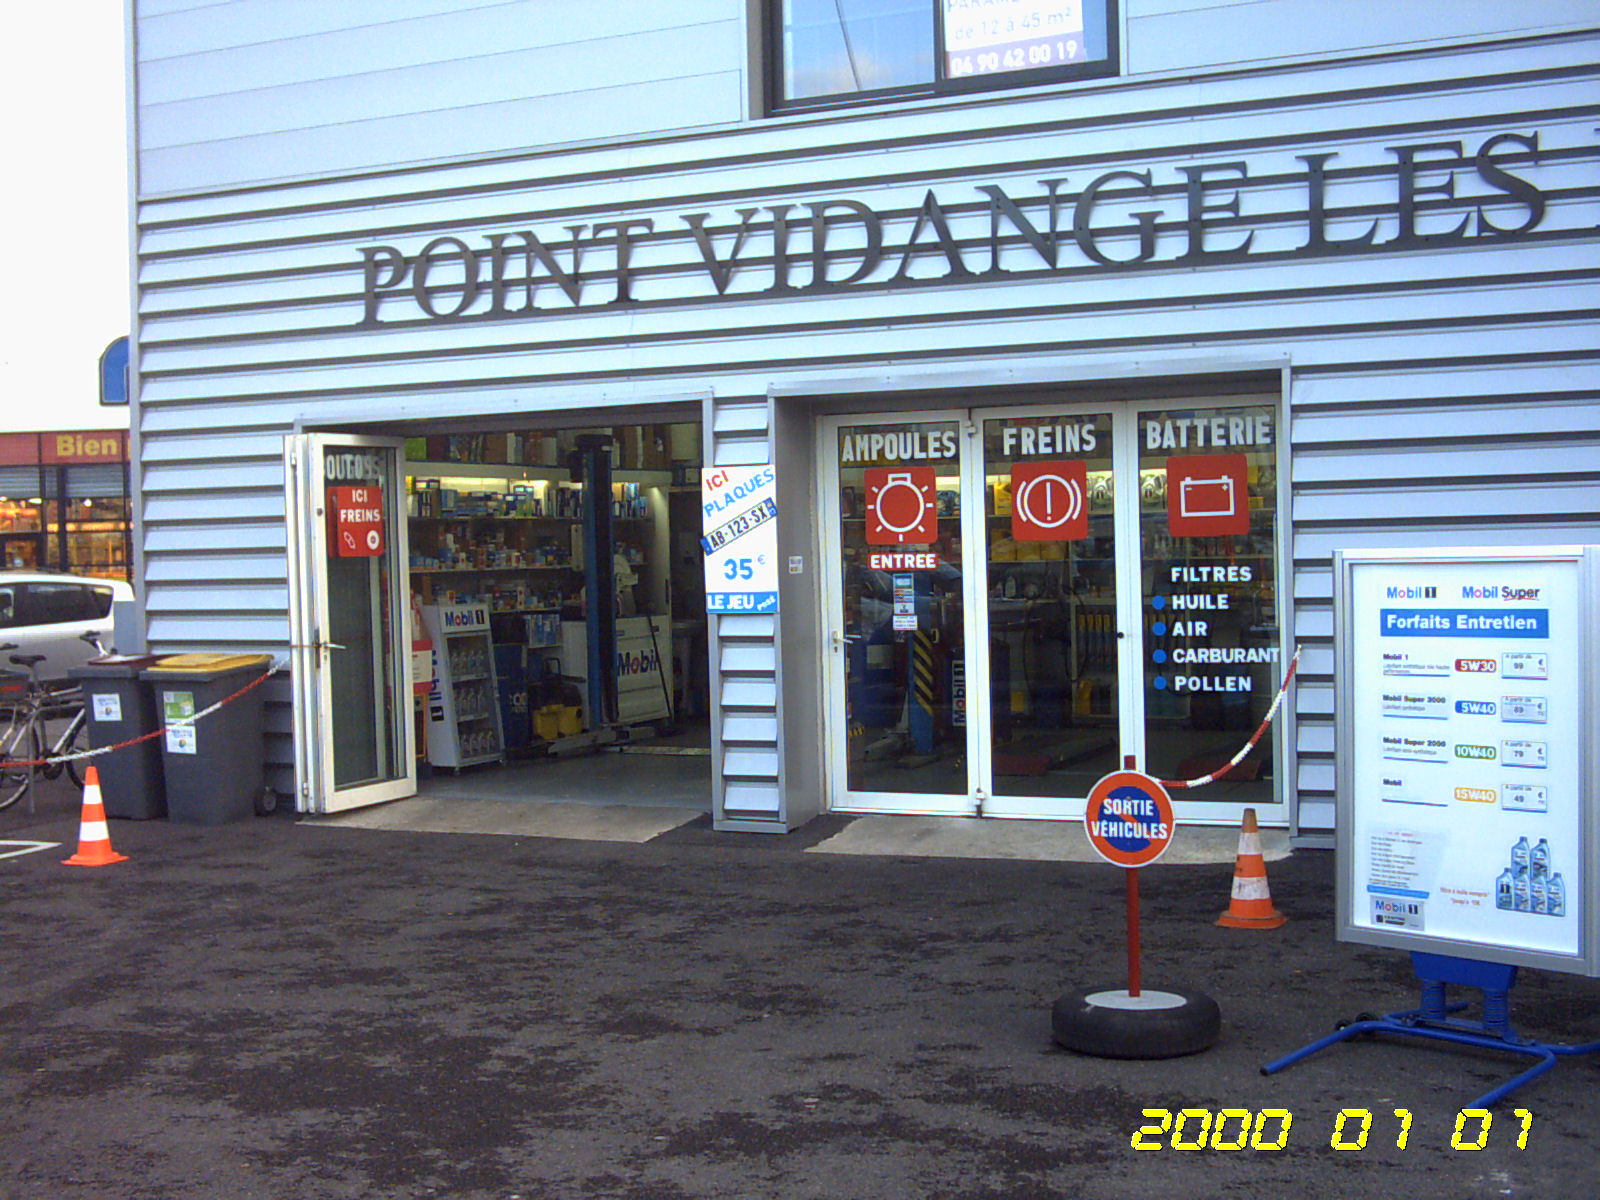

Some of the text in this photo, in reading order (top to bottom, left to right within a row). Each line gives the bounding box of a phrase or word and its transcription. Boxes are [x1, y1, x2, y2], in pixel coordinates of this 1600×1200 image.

[1029, 44, 1051, 64] 00
[1056, 40, 1077, 60] 19
[355, 130, 1547, 327] POINT VIDANGE LES
[1002, 424, 1097, 456] FREINS
[1146, 415, 1271, 450] BATTERIE
[57, 434, 117, 456] Bien
[841, 430, 956, 462] AMPOULES
[705, 470, 728, 491] ICI
[352, 489, 368, 503] ICI
[703, 467, 775, 517] PLAQUES
[340, 508, 381, 523] FREINS
[723, 558, 754, 580] 35
[870, 553, 936, 569] ENTREE
[1171, 566, 1252, 582] FILTRES
[1386, 586, 1422, 599] Mobil
[1462, 585, 1540, 600] Mobil Super
[707, 594, 725, 610] LE
[727, 594, 754, 610] JEU
[1172, 594, 1229, 610] HUILE
[445, 610, 474, 626] Mobil
[1386, 614, 1537, 630] Forfaits Entretien
[1172, 621, 1208, 636] AIR
[1172, 647, 1280, 664] CARBURANT
[1460, 661, 1495, 671] 5W30
[1174, 676, 1252, 692] POLLEN
[1460, 703, 1495, 714] 5W40
[1456, 745, 1495, 758] 10W40
[1103, 798, 1154, 816] SORTIE
[1375, 900, 1406, 913] Mobil
